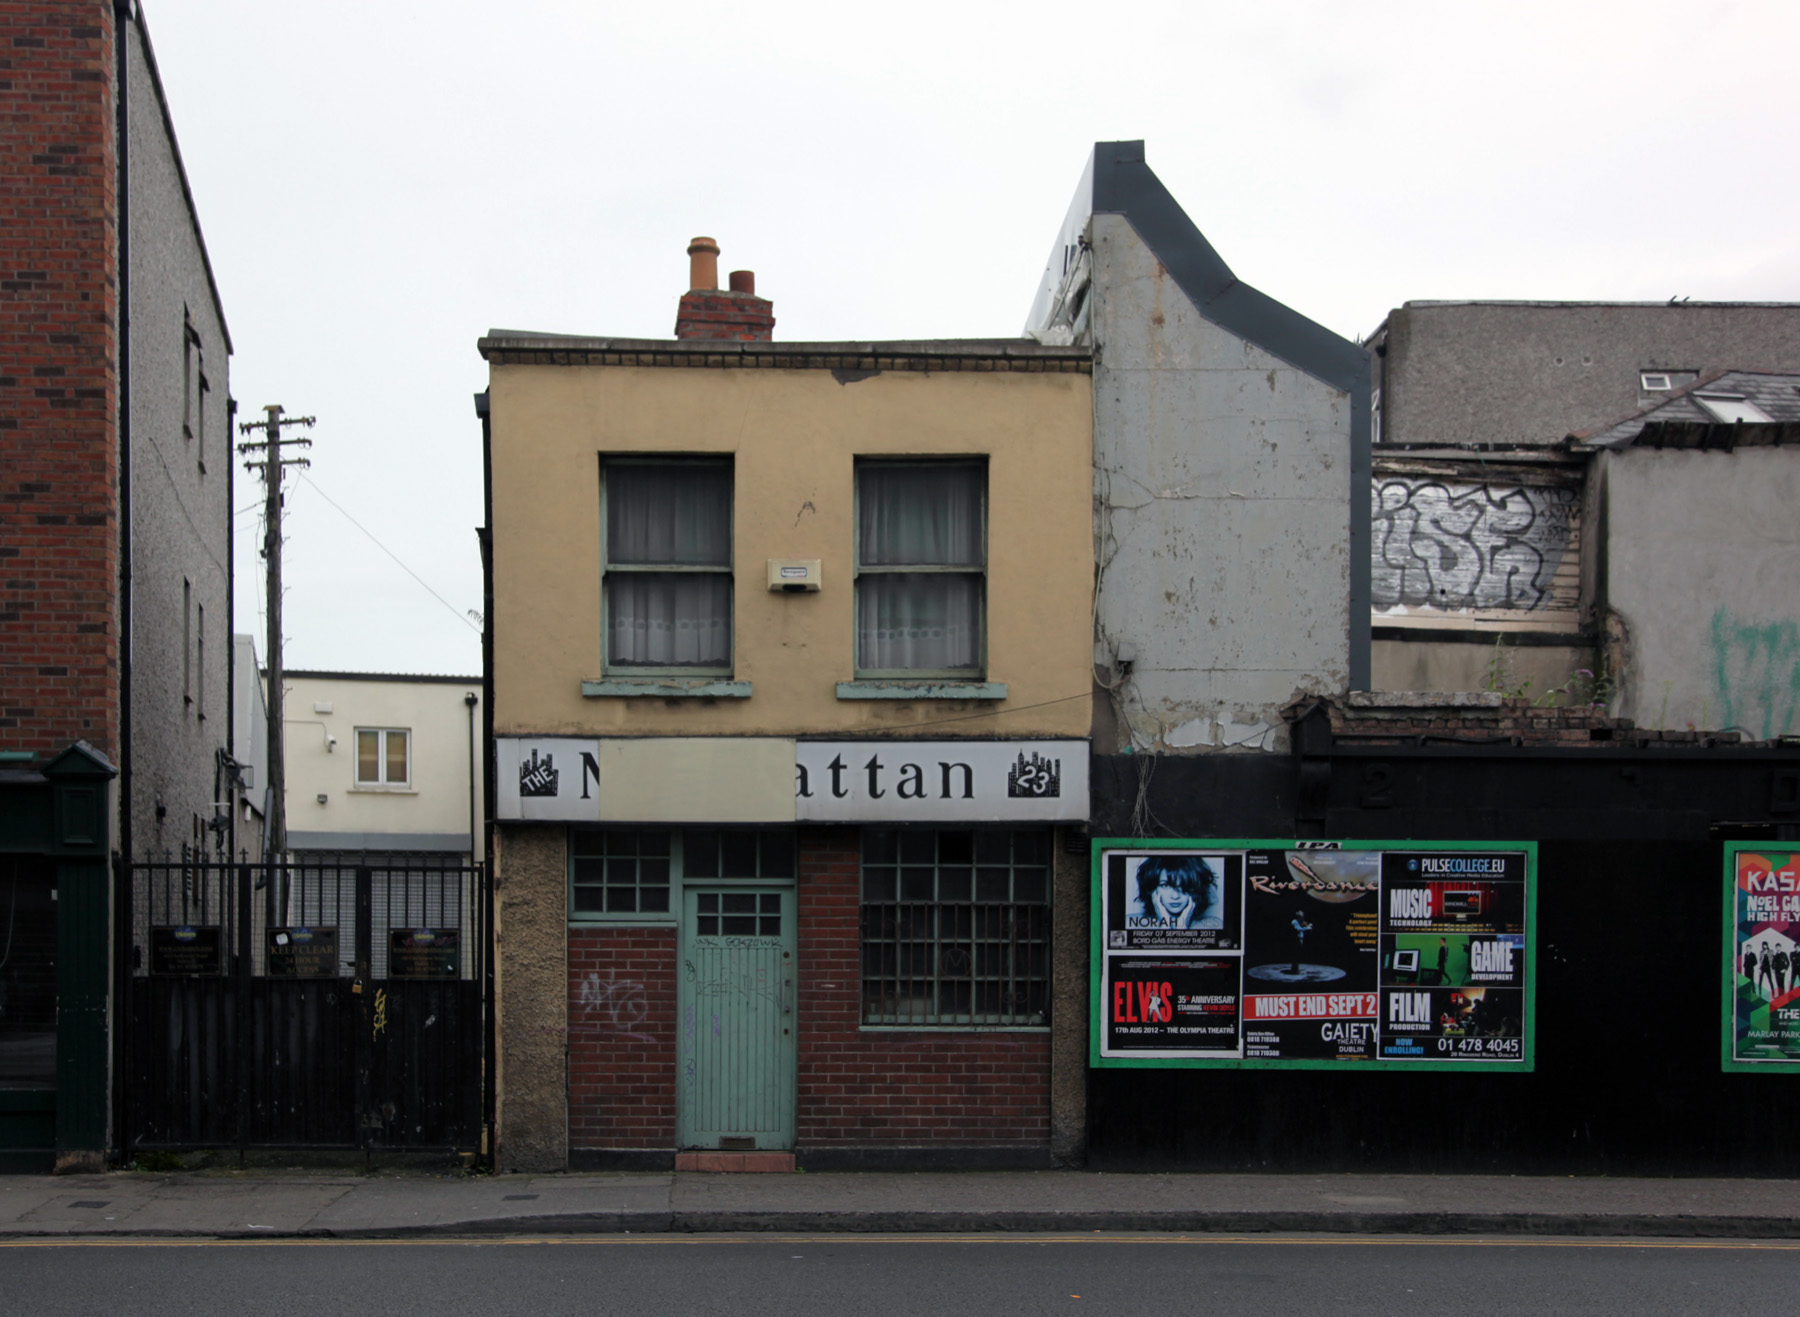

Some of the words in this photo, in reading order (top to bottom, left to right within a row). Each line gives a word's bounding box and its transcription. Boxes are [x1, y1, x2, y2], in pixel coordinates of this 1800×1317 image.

[521, 765, 554, 791] THE
[1016, 765, 1050, 794] 23
[1421, 858, 1505, 872] PULSECOLLEGE.EU
[1249, 856, 1379, 895] Riverdance
[1747, 871, 1800, 891] KAS
[1390, 888, 1432, 919] MUSIC
[1747, 895, 1780, 911] NOEL
[1129, 917, 1178, 927] NORAH
[1179, 917, 1221, 927] JNES
[1390, 919, 1432, 927] TECHNOLOGY
[1747, 912, 1778, 922] HIGH
[271, 945, 298, 955] KEEP
[299, 945, 334, 954] CLEAR
[1471, 940, 1514, 972] GAME
[296, 956, 320, 964] HOUR
[1471, 973, 1513, 981] DEVELOPMENT
[1114, 981, 1173, 1023] ELVIS
[1177, 995, 1191, 1004] 35
[1191, 995, 1236, 1004] ANNIVERSARY
[1255, 996, 1297, 1017] MUST
[1299, 995, 1327, 1016] END
[1328, 995, 1364, 1015] SEPT
[1366, 995, 1376, 1015] 2
[1389, 992, 1431, 1022] FILM
[1777, 1008, 1800, 1020] THE
[1321, 1022, 1378, 1043] GAIETY
[1389, 1023, 1431, 1031] PRODUCTION
[1395, 1038, 1413, 1046] NOW
[1438, 1038, 1453, 1051] 01
[1458, 1038, 1483, 1051] 478
[1486, 1038, 1519, 1052] 4045
[1384, 1046, 1424, 1055] ENROLLING!
